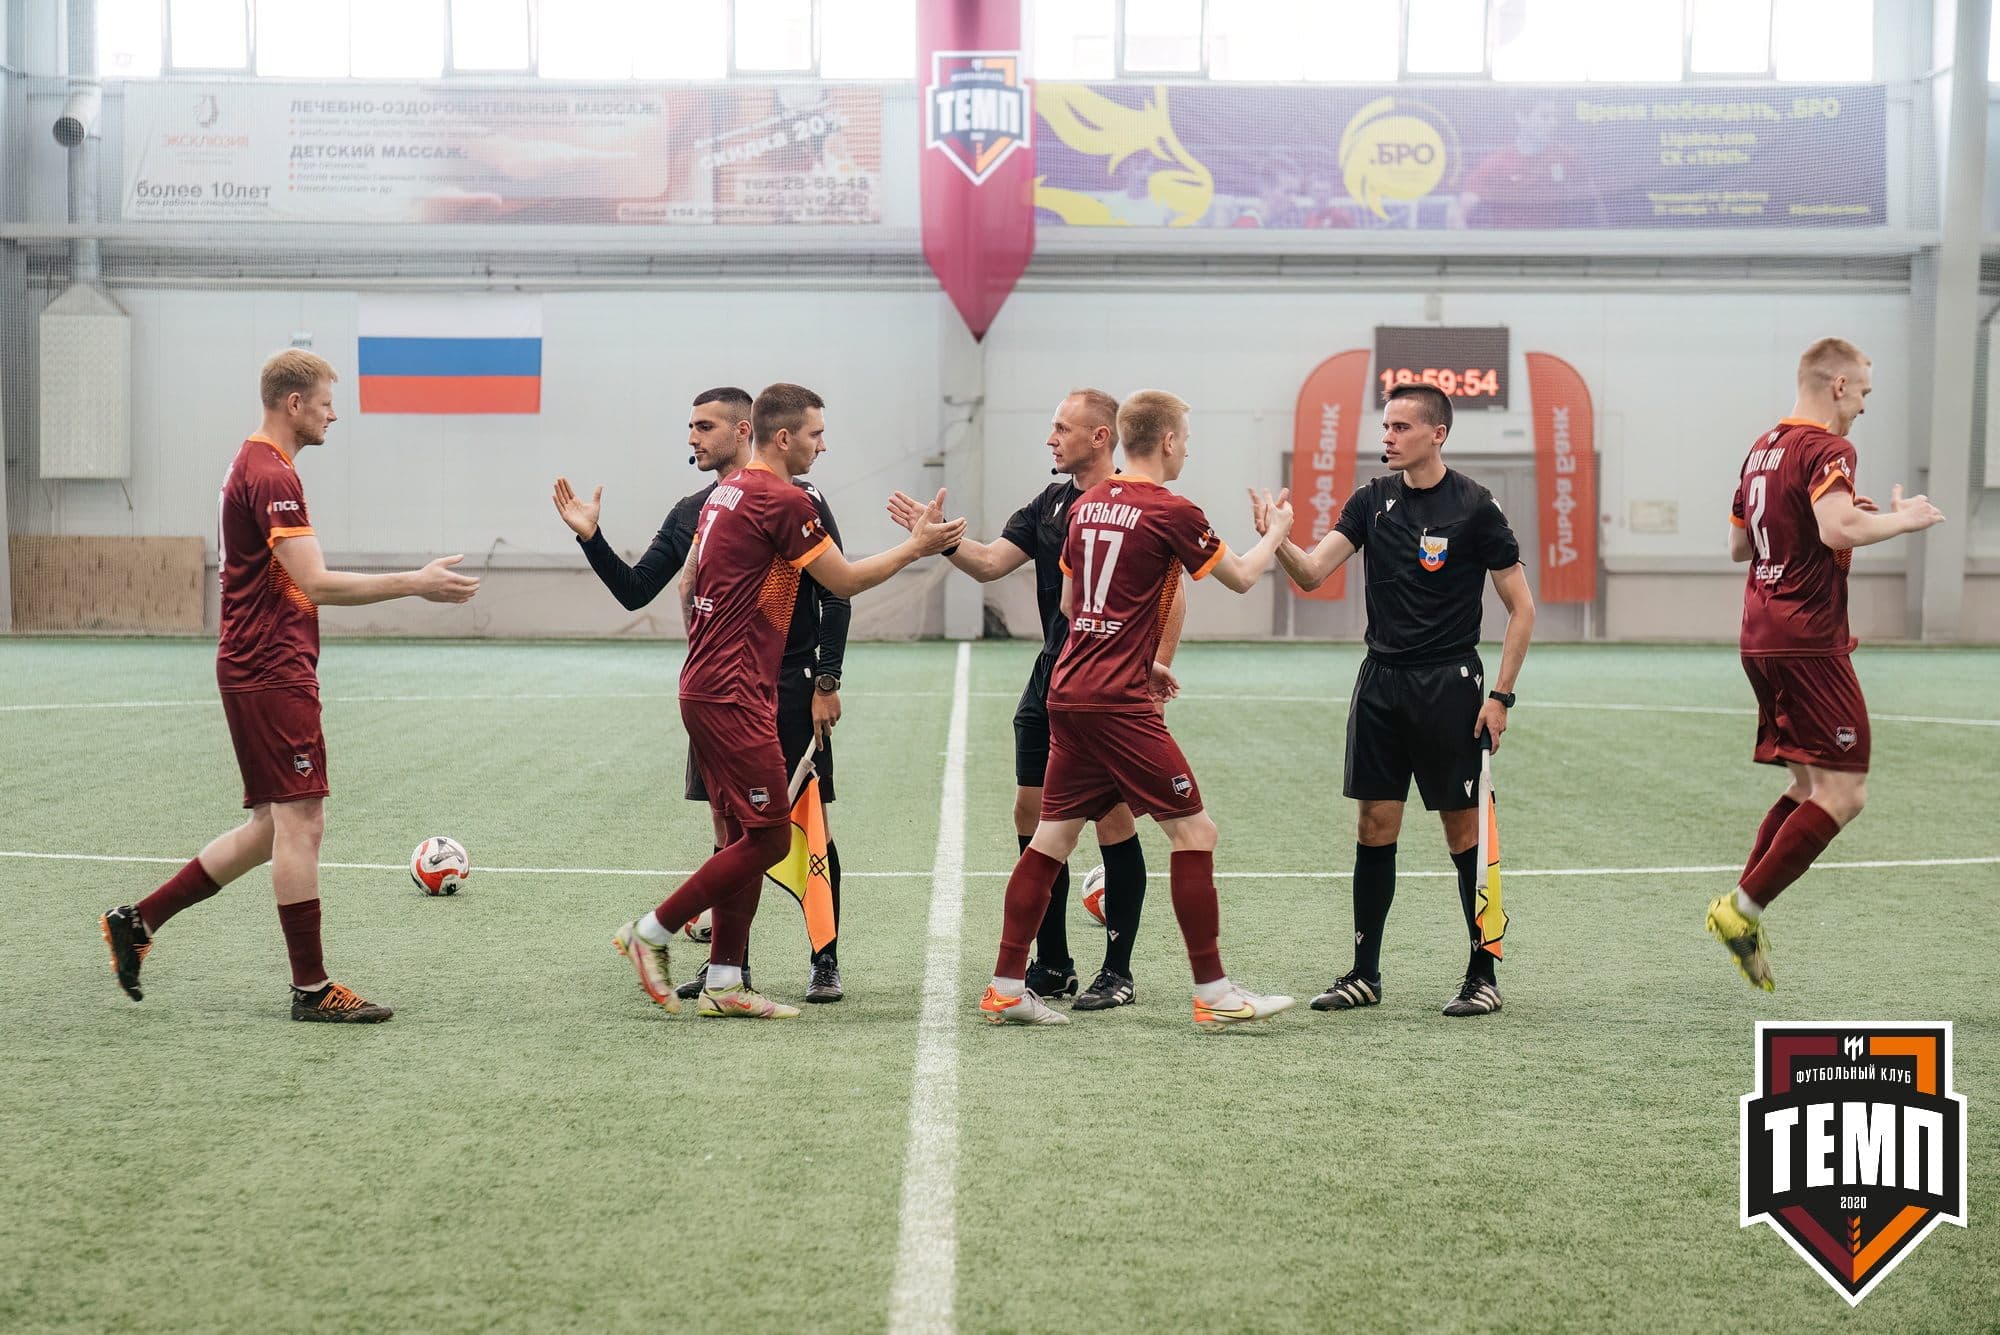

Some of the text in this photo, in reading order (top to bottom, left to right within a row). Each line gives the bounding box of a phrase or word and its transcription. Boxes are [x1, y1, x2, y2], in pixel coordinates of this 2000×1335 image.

[935, 87, 1021, 134] ТЕМП
[289, 142, 469, 160] ДЕТСКИЙ МАССАЖ:
[136, 180, 203, 199] более
[272, 500, 300, 512] ПСБ
[1076, 502, 1143, 530] КУЗЬКИН
[1306, 475, 1338, 555] льфа
[1749, 475, 1771, 560] 2
[1080, 528, 1125, 614] 17
